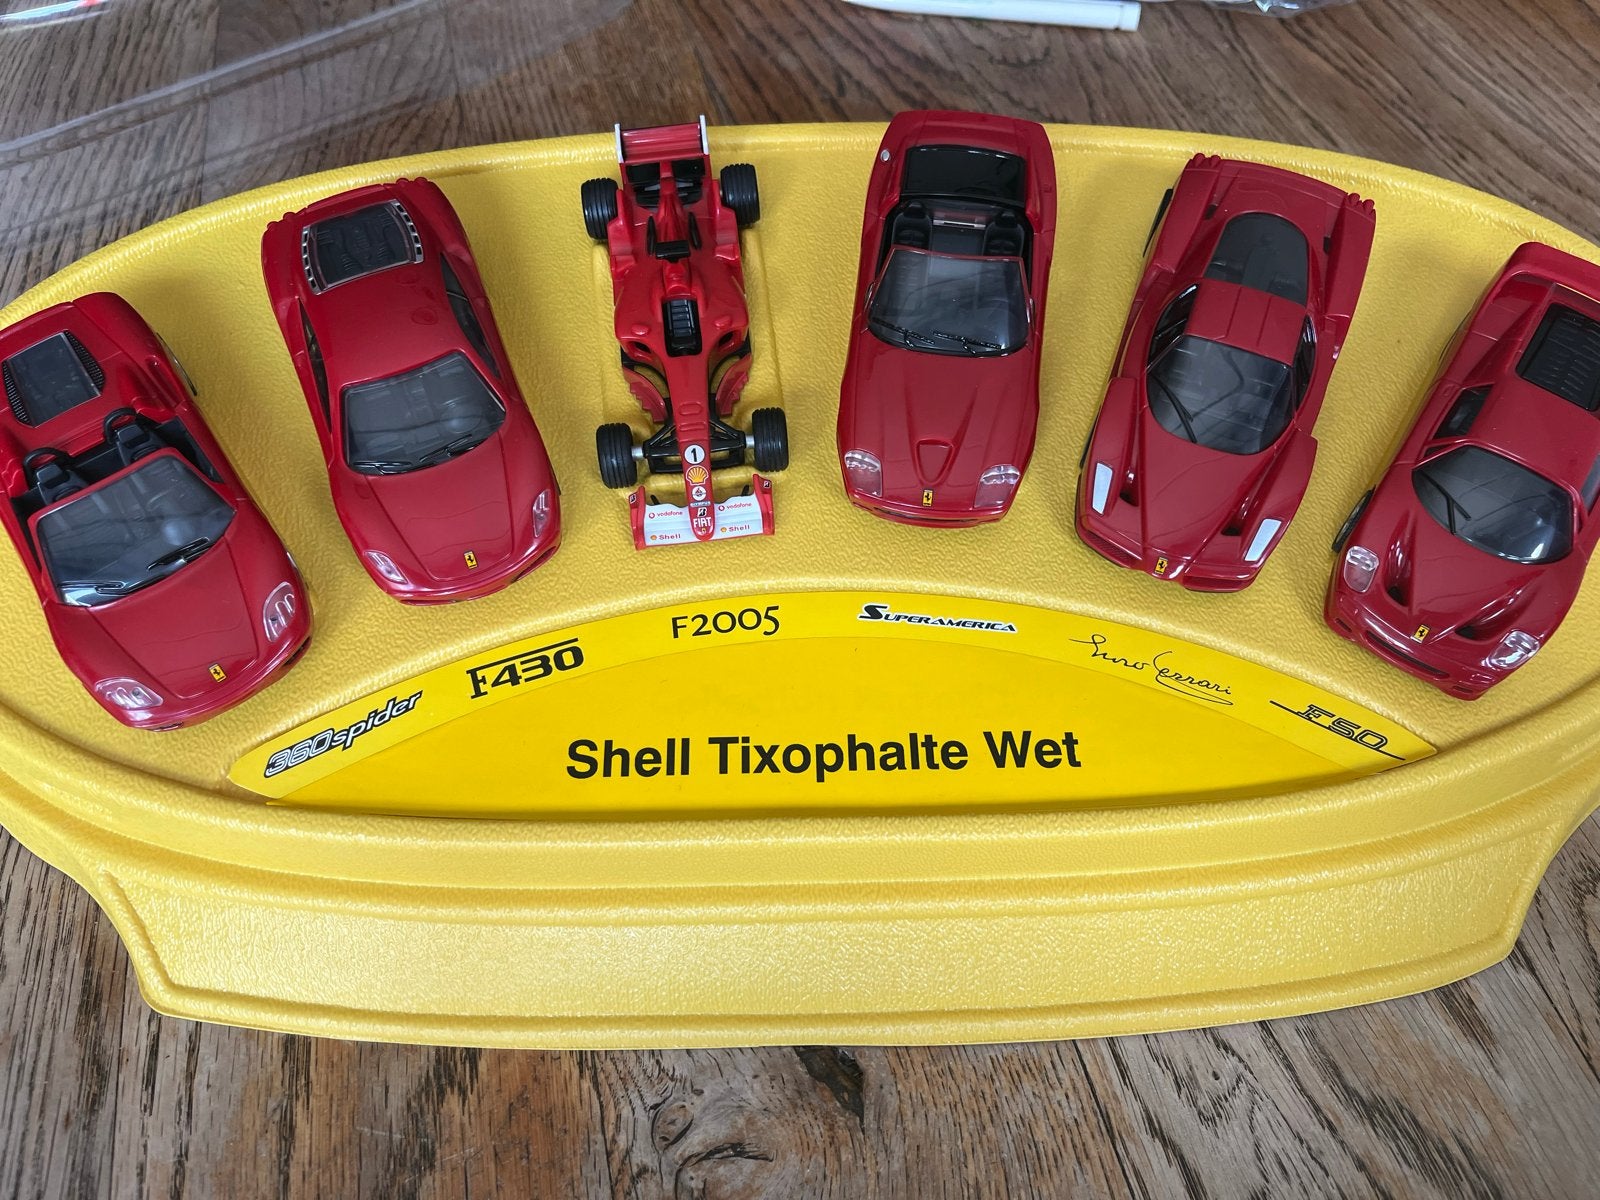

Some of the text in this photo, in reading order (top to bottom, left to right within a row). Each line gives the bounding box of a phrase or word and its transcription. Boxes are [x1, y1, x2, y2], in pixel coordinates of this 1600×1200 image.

[690, 448, 698, 463] 1
[726, 502, 752, 510] vodafone
[658, 533, 681, 541] Shell
[692, 517, 712, 528] FIAT
[728, 524, 750, 532] Shell
[671, 606, 780, 639] F2005
[858, 604, 1017, 633] SUPERAMERICA
[466, 638, 584, 700] F430
[264, 691, 423, 779] 360spider
[1294, 702, 1389, 752] F50
[566, 730, 1082, 785] Shell Tixophalte Wet
